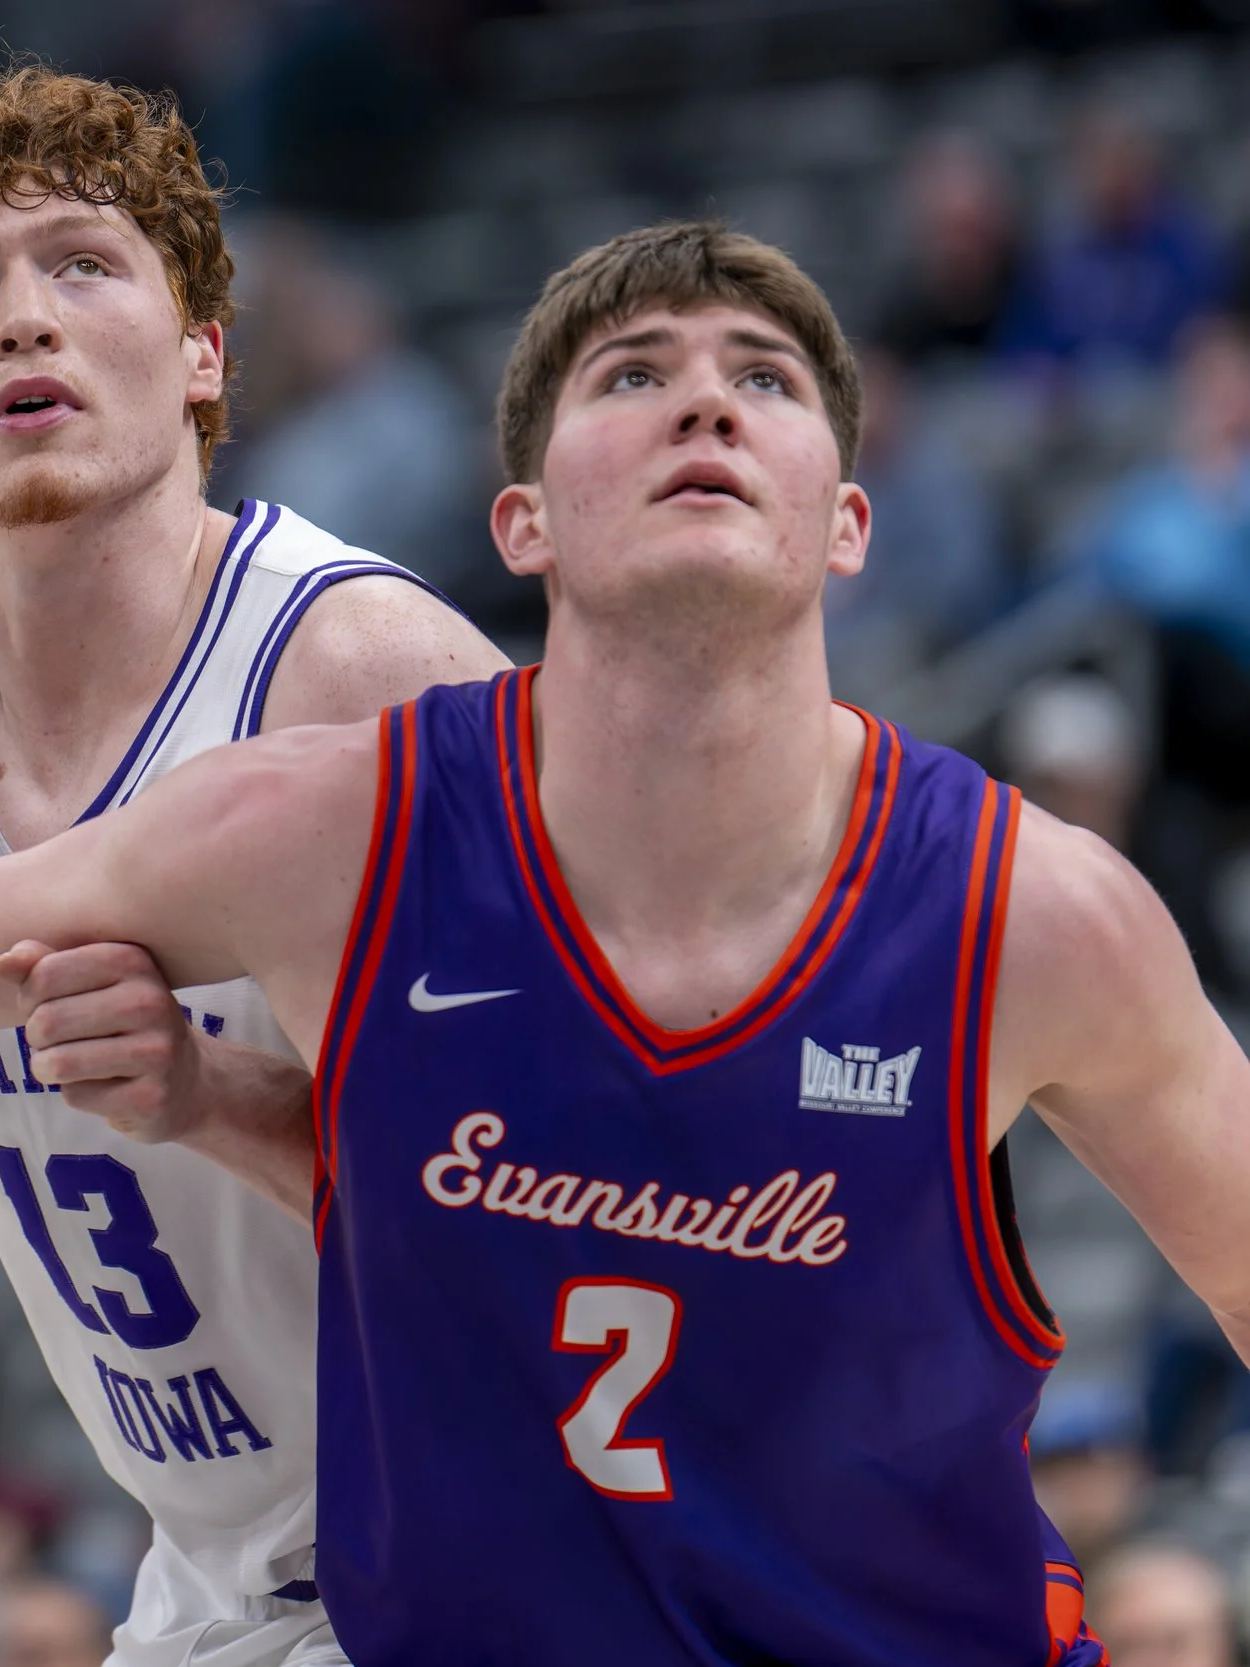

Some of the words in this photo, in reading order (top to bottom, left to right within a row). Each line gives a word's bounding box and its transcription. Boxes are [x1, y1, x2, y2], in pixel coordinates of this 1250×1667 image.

[800, 1036, 922, 1105] VALLEY
[842, 1044, 881, 1062] THE
[422, 1111, 849, 1266] Evansville
[93, 1354, 273, 1464] IOWA
[552, 1276, 683, 1502] 2
